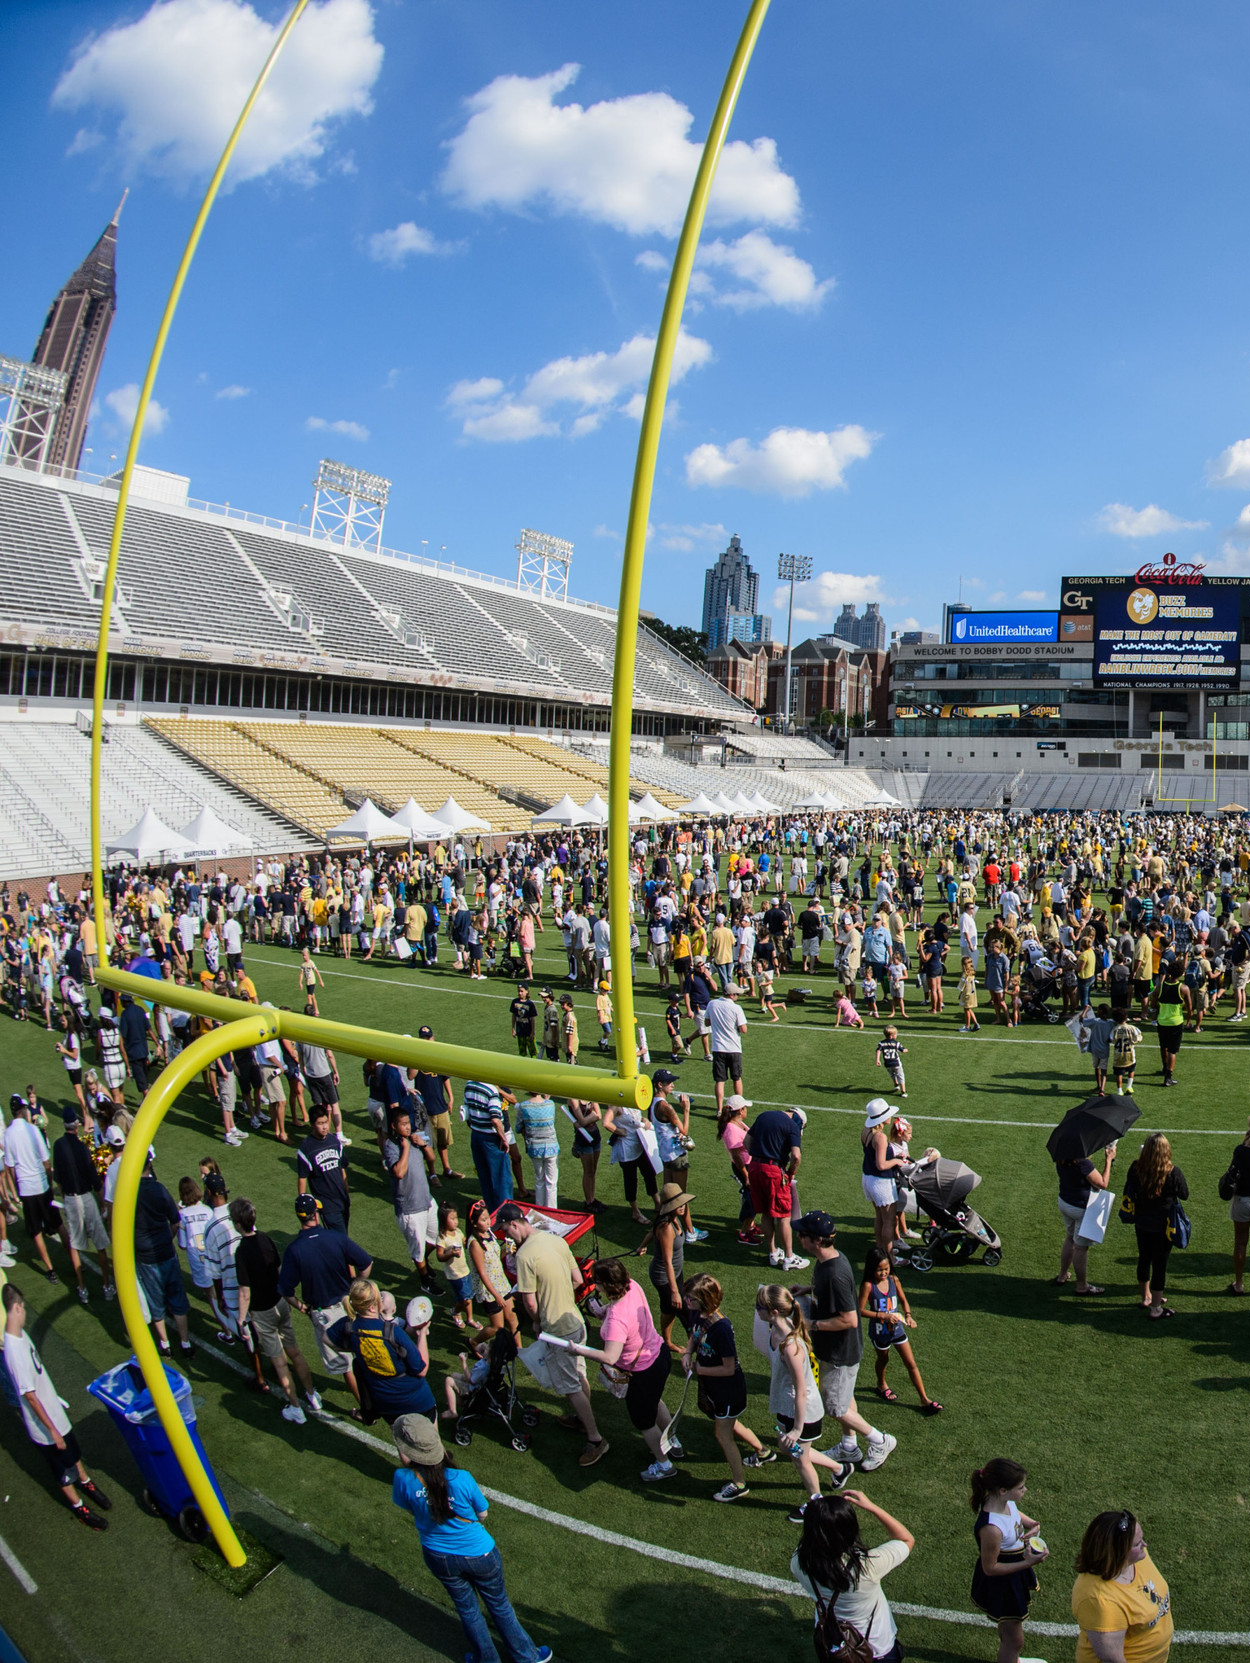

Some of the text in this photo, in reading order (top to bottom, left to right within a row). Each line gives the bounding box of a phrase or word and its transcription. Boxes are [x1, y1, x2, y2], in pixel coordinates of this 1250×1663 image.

[1135, 563, 1207, 585] Coca-Cola
[1068, 577, 1103, 585] GEORGIA
[1063, 591, 1093, 610] GT
[1159, 595, 1186, 606] BUZZ
[1159, 607, 1214, 618] MEMORIES
[45, 626, 72, 635] COLLEGE
[969, 625, 1053, 637] UnitedHealthcare
[1099, 630, 1237, 641] MAKE THE MOST OUT OF GAMEDAY!
[34, 634, 60, 646] HALL
[61, 637, 76, 648] OF
[122, 645, 165, 657] BAUGHAN
[179, 650, 212, 660] MORRIS
[914, 648, 957, 656] WELCOME
[974, 647, 1003, 655] BOBBY
[1006, 647, 1032, 655] DODD
[1034, 647, 1075, 655] STADIUM
[1113, 740, 1213, 752] Georgia Tech
[184, 850, 217, 858] QUARTERBACKS
[1114, 1038, 1131, 1052] 42
[884, 1049, 896, 1059] 37
[315, 1148, 340, 1165] GEORGIA
[320, 1160, 339, 1172] TECH
